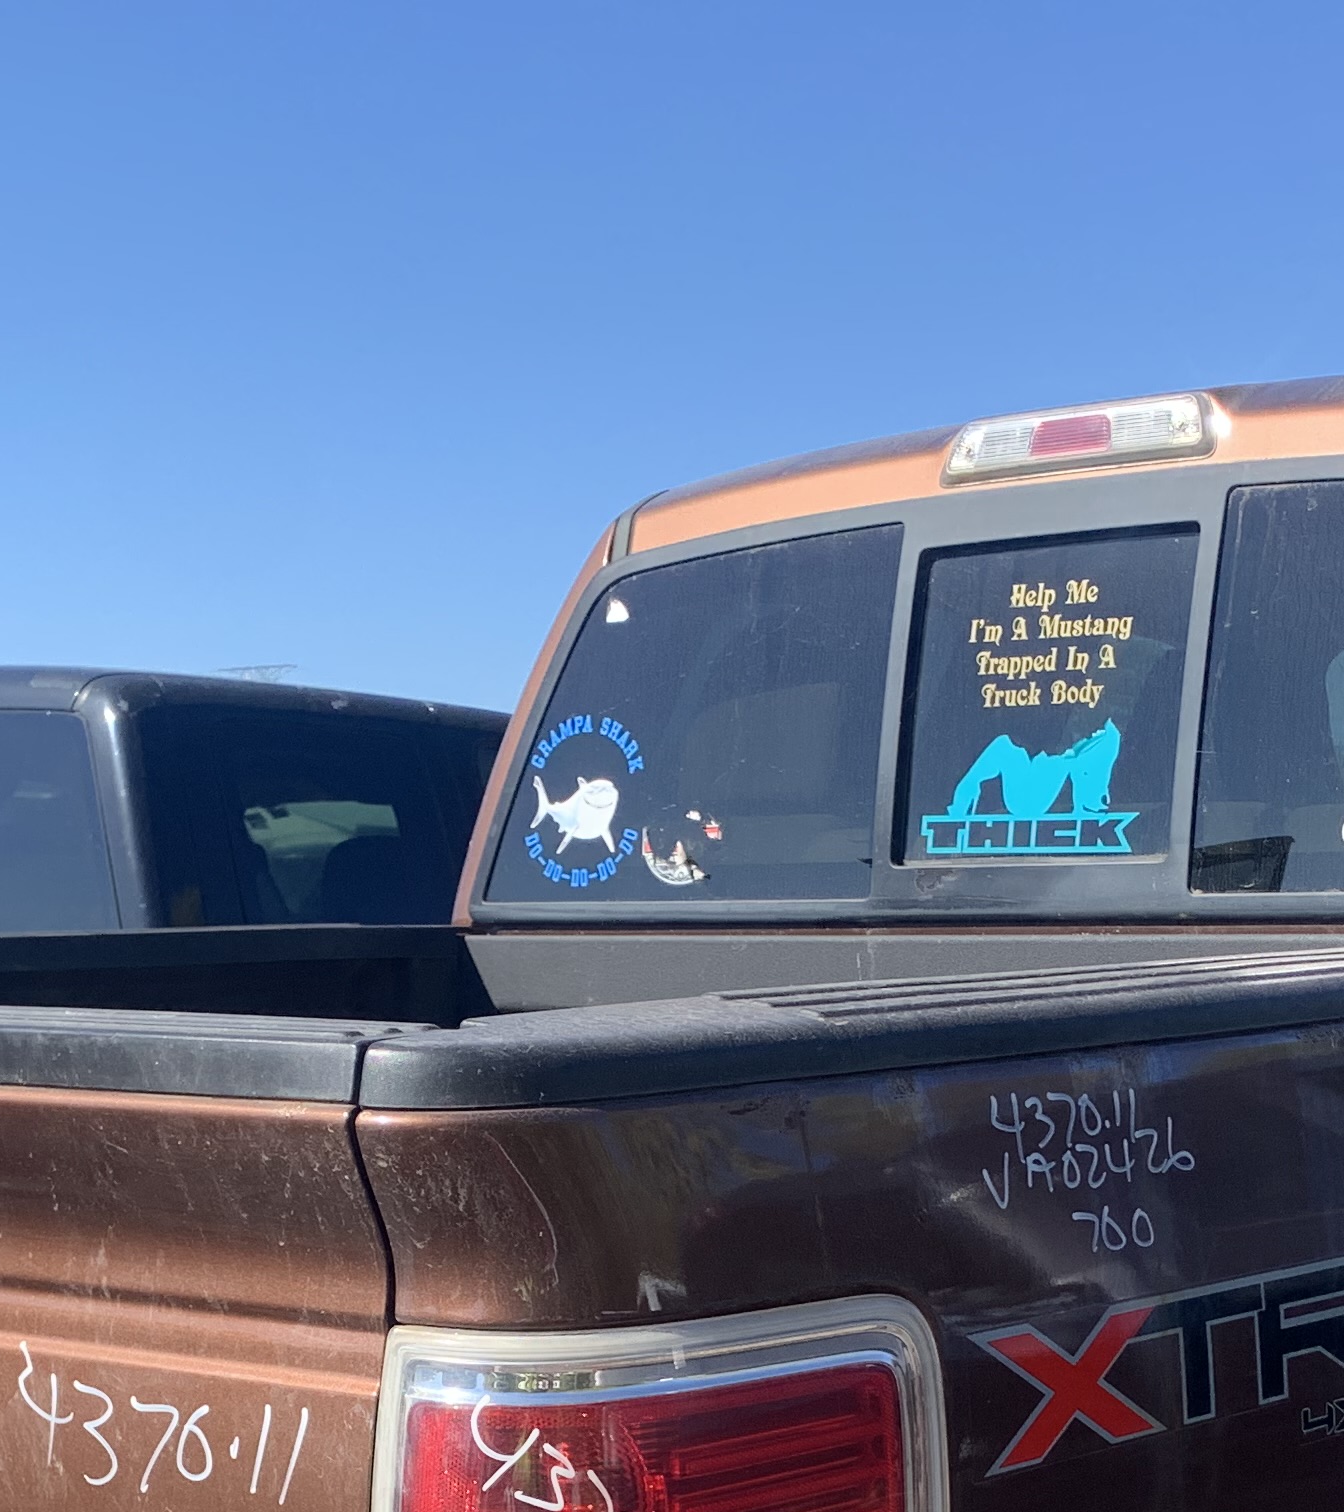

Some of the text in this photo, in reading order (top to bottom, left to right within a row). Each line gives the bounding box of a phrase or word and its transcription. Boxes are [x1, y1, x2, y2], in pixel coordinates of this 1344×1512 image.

[1009, 579, 1099, 612] Help Me
[968, 613, 1134, 646] I'm A Mustang
[976, 643, 1117, 680] Trapped In A
[981, 678, 1104, 709] Truck Body
[530, 714, 645, 775] GRAMPA SHARK
[924, 816, 1132, 852] THICK
[990, 1087, 1136, 1164] 4370.11
